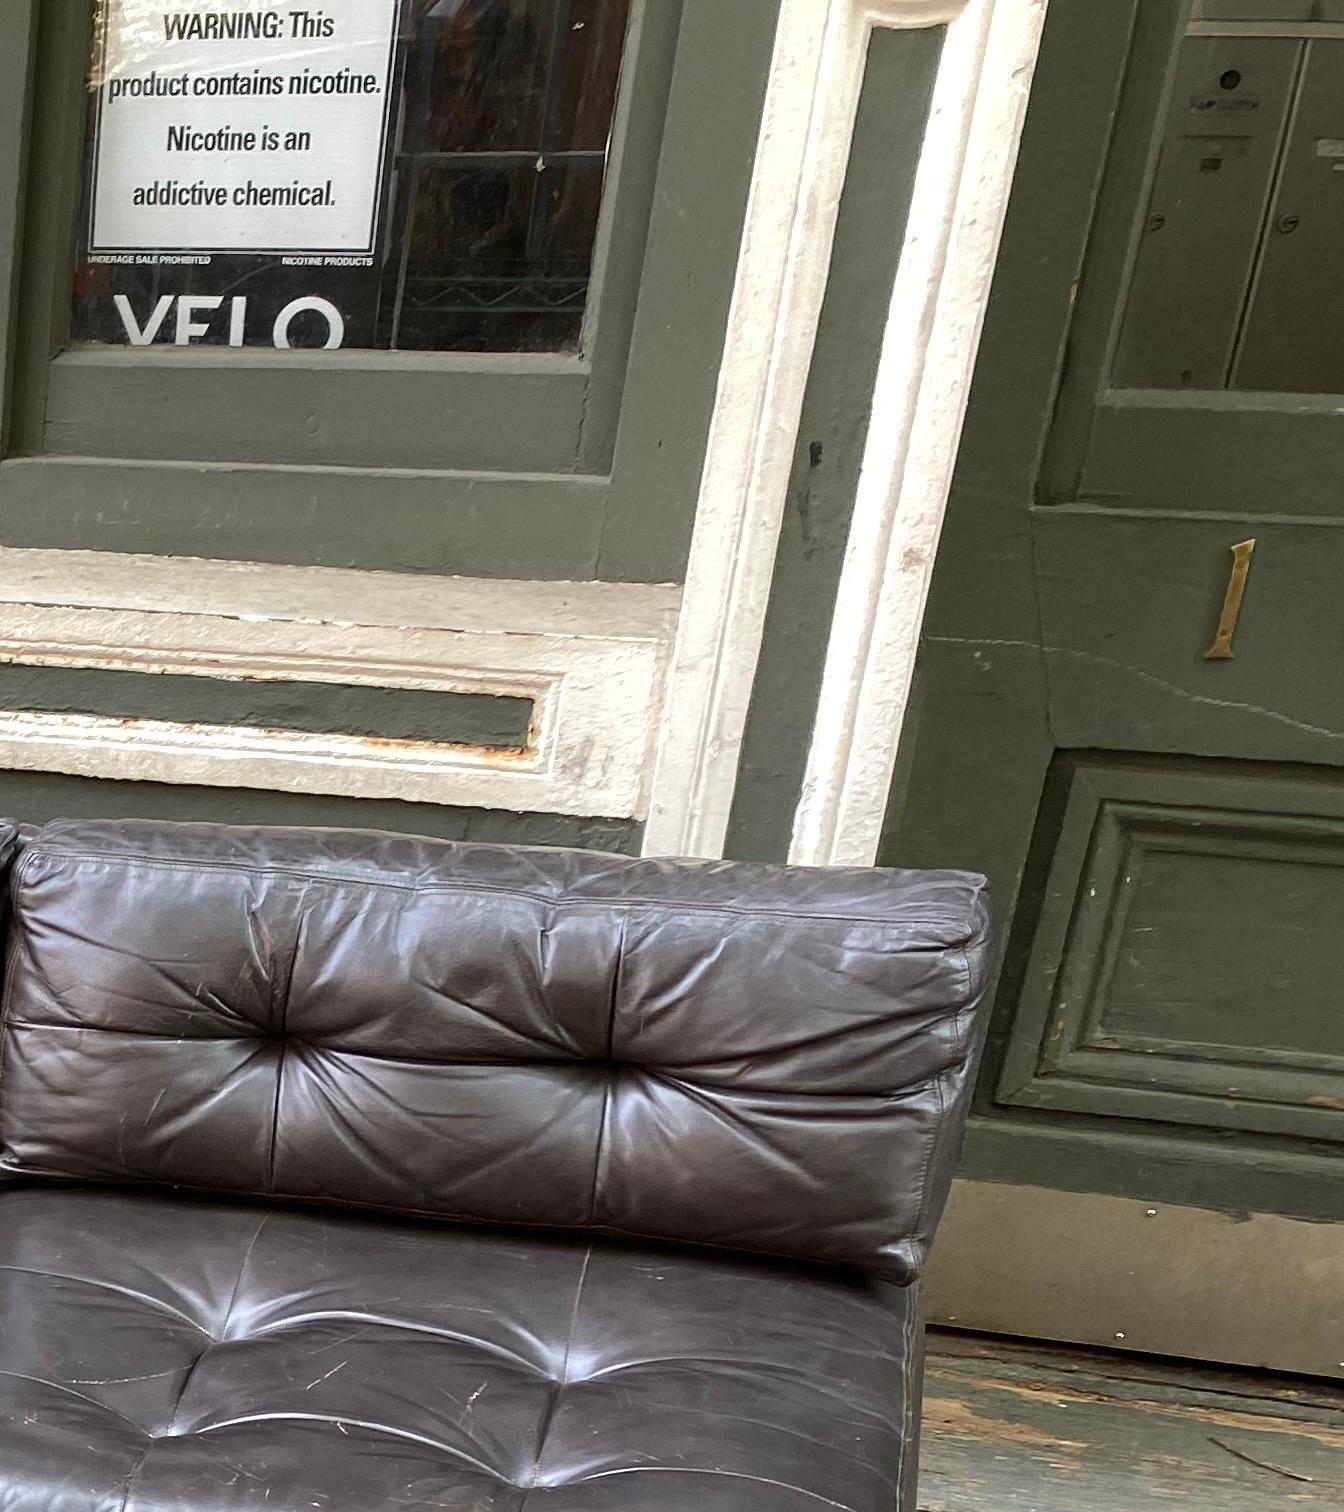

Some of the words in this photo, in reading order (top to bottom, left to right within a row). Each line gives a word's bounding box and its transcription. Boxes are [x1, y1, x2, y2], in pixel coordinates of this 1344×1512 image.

[163, 11, 284, 41] WARNING:
[288, 10, 335, 38] This
[108, 70, 190, 104] product
[192, 68, 285, 96] contains
[287, 66, 382, 95] nicotine.
[166, 124, 257, 152] Nicotine
[261, 124, 280, 151] is
[284, 130, 312, 151] an
[132, 180, 228, 207] addictive
[232, 180, 337, 207] chemical.
[87, 255, 135, 265] UNDERAGE
[135, 255, 159, 265] SALE
[159, 255, 212, 265] PROHIBITED
[282, 256, 323, 265] NICOTINE
[323, 257, 374, 267] PRODUCTS
